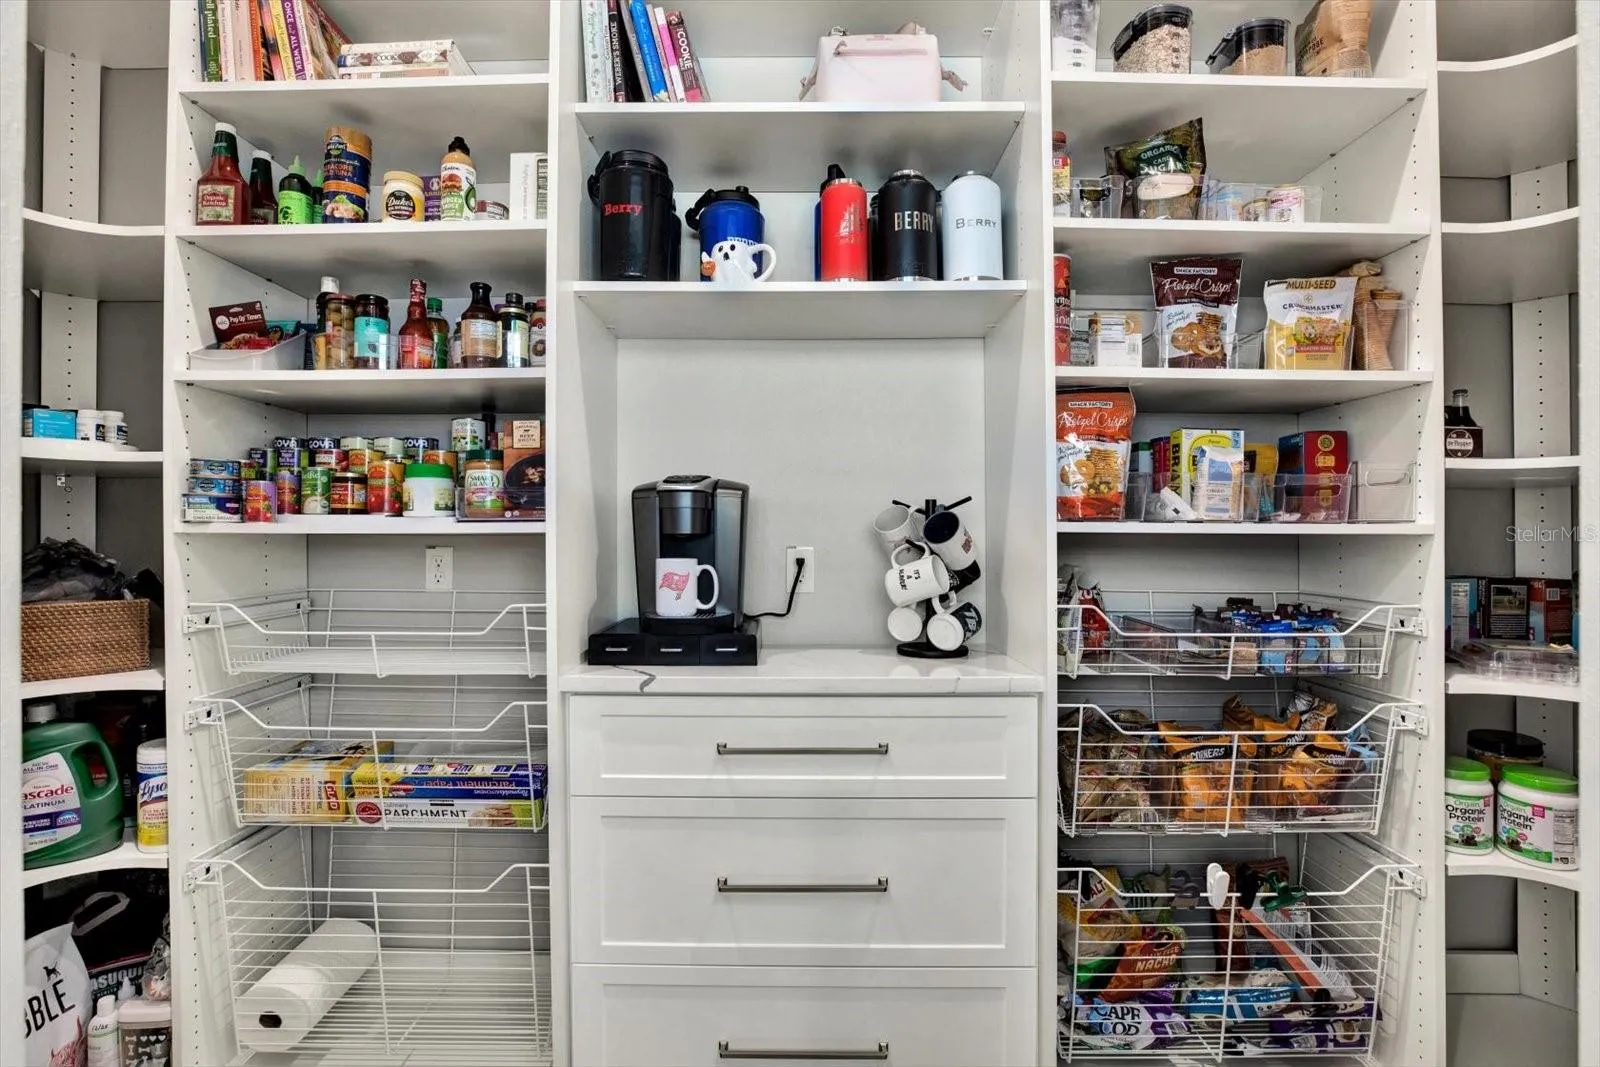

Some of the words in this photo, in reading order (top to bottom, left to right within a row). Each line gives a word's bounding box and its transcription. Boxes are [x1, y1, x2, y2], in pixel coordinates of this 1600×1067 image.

[284, 2, 294, 23] ONCE
[205, 10, 217, 38] plated
[290, 36, 300, 49] ALL
[610, 22, 620, 49] SMOKE
[677, 31, 693, 70] COOKIE
[292, 49, 303, 71] WEEK
[1141, 145, 1179, 160] ORGANIC
[1140, 157, 1184, 175] SUGAR
[388, 196, 413, 207] Duke's
[604, 203, 642, 217] Berry
[895, 211, 934, 233] BERRY
[1162, 278, 1201, 296] Pretzel
[1286, 279, 1336, 290] MULTI-SEED
[1058, 412, 1096, 431] Pretzel
[384, 809, 468, 818] PARCHMENT
[1445, 805, 1486, 815] Organic
[1449, 812, 1485, 822] Protein
[1499, 804, 1536, 824] Organic
[1500, 813, 1533, 831] Protein
[1135, 954, 1177, 972] NACHO
[1093, 1005, 1141, 1023] CAPE
[1101, 1018, 1139, 1036] COD
